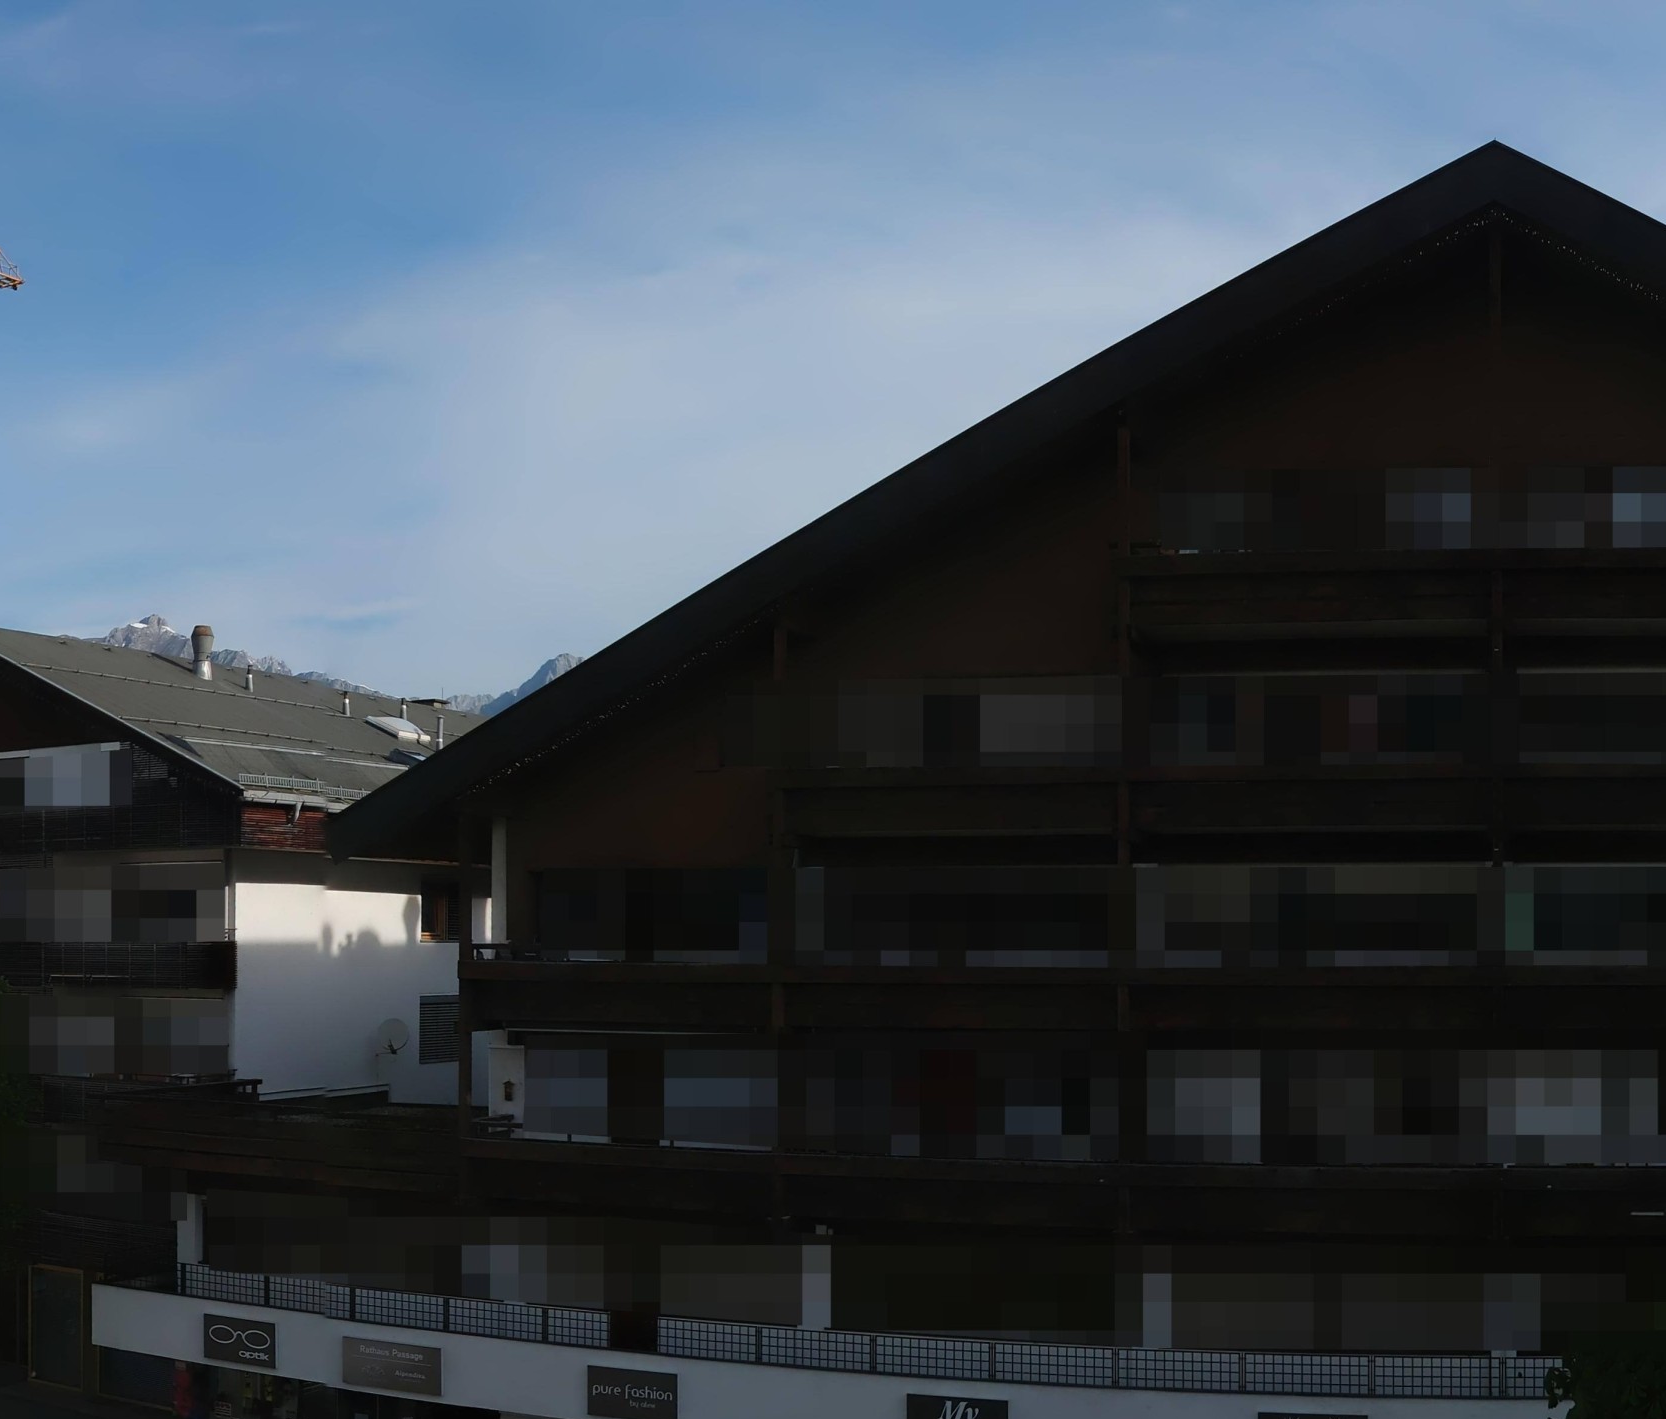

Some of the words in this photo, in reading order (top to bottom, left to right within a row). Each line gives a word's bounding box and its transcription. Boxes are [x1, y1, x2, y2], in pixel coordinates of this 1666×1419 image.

[238, 1350, 270, 1362] optik
[359, 1345, 390, 1357] Rathaus
[391, 1348, 424, 1362] Passage
[592, 1383, 622, 1397] pure
[624, 1384, 673, 1401] fashion
